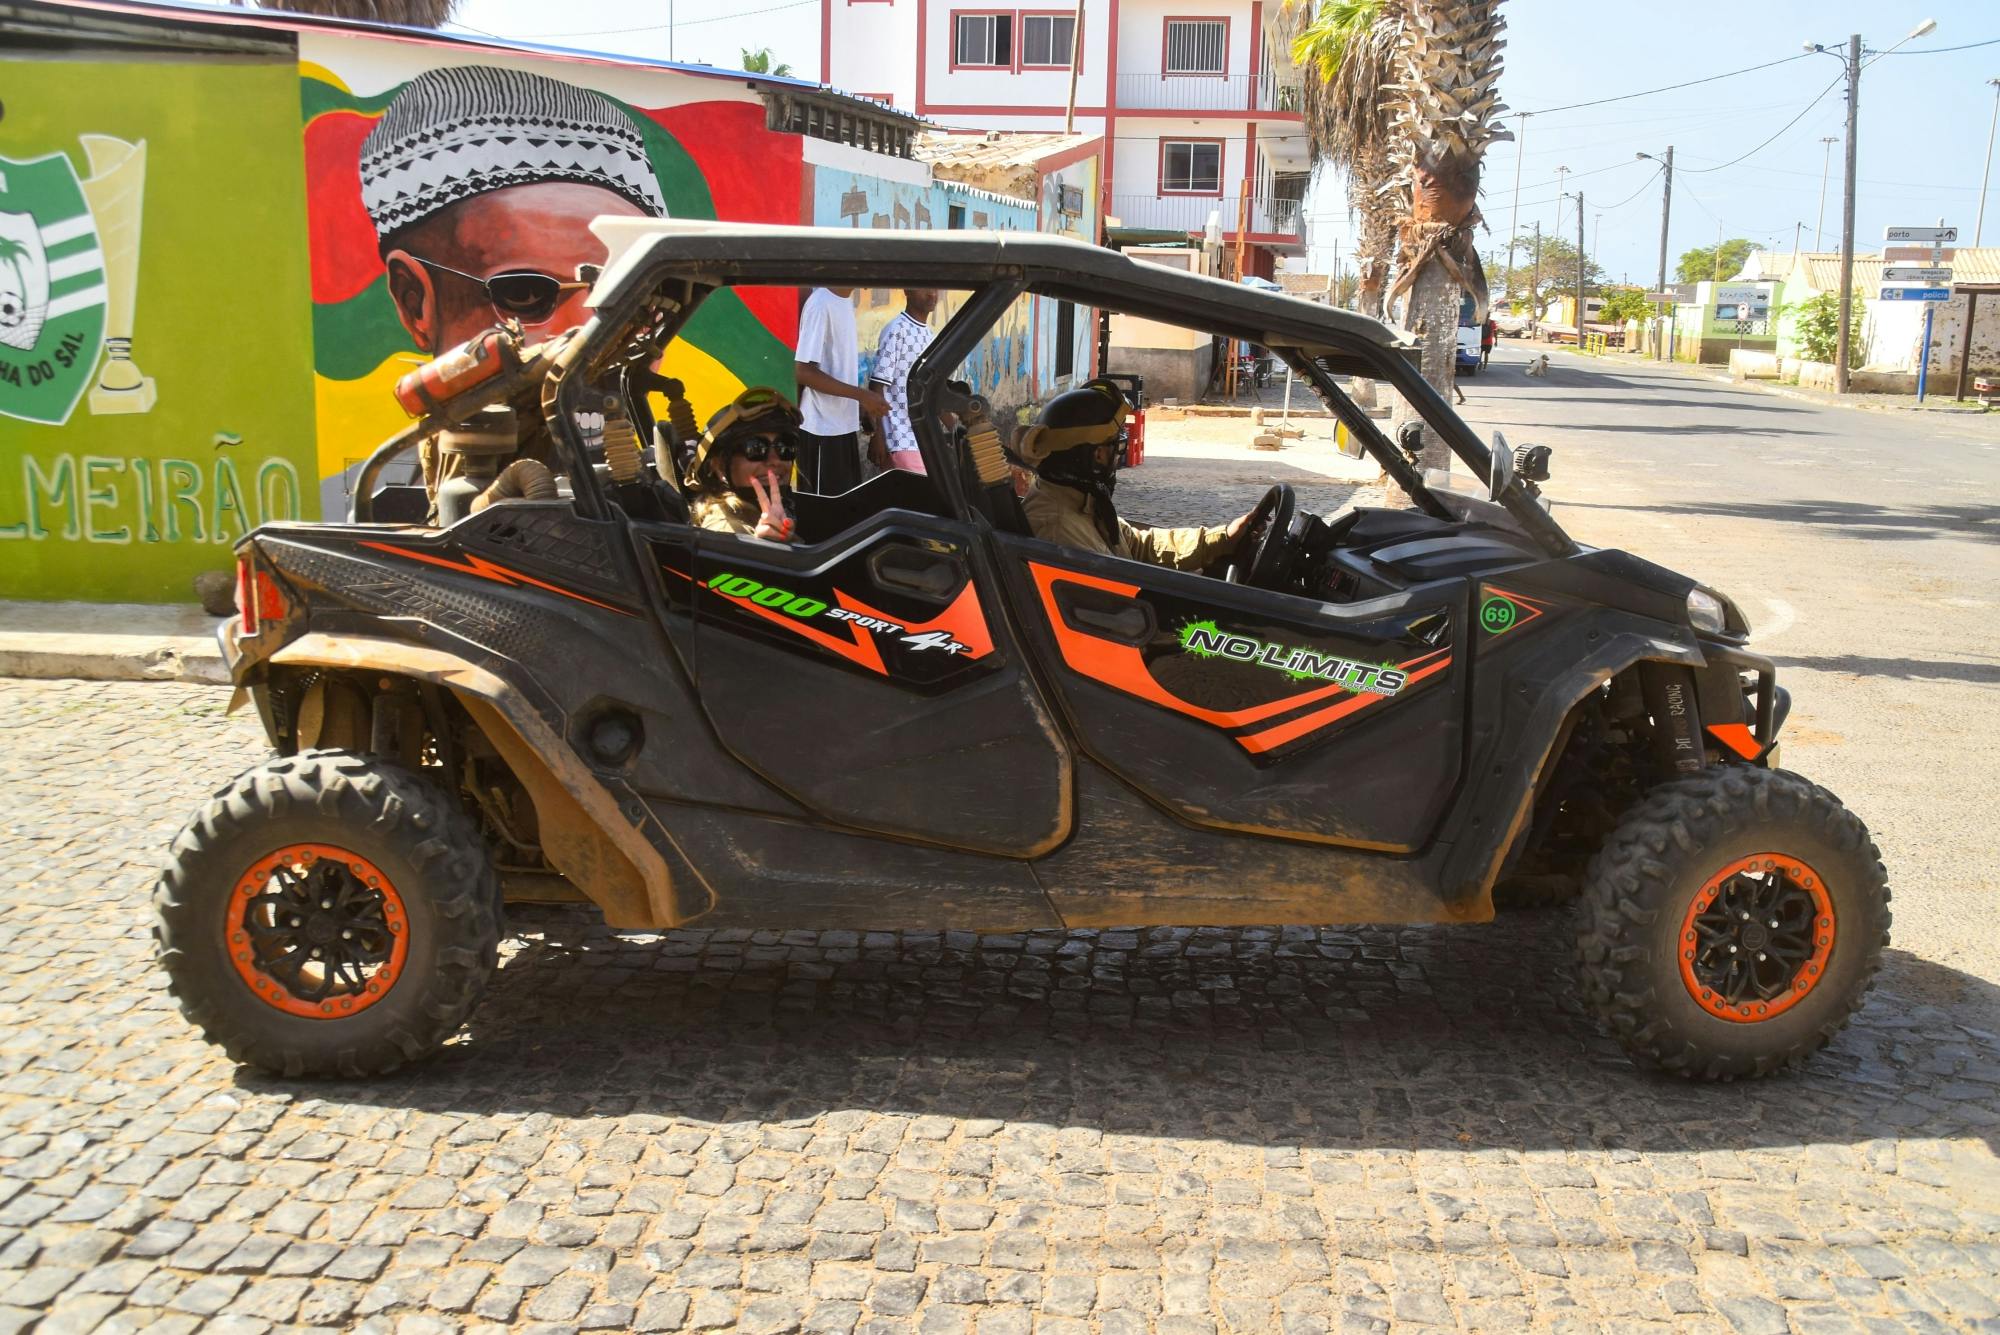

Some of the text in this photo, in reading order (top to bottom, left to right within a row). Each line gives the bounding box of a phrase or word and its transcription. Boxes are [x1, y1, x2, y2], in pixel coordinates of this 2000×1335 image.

[1888, 230, 1910, 238] porto
[27, 361, 55, 387] DO
[54, 332, 84, 368] SAL
[708, 573, 828, 617] 1000
[825, 608, 904, 633] SPORT
[1485, 607, 1510, 624] 69
[1339, 681, 1397, 697] ADVENTURE
[1665, 684, 1686, 716] RACING
